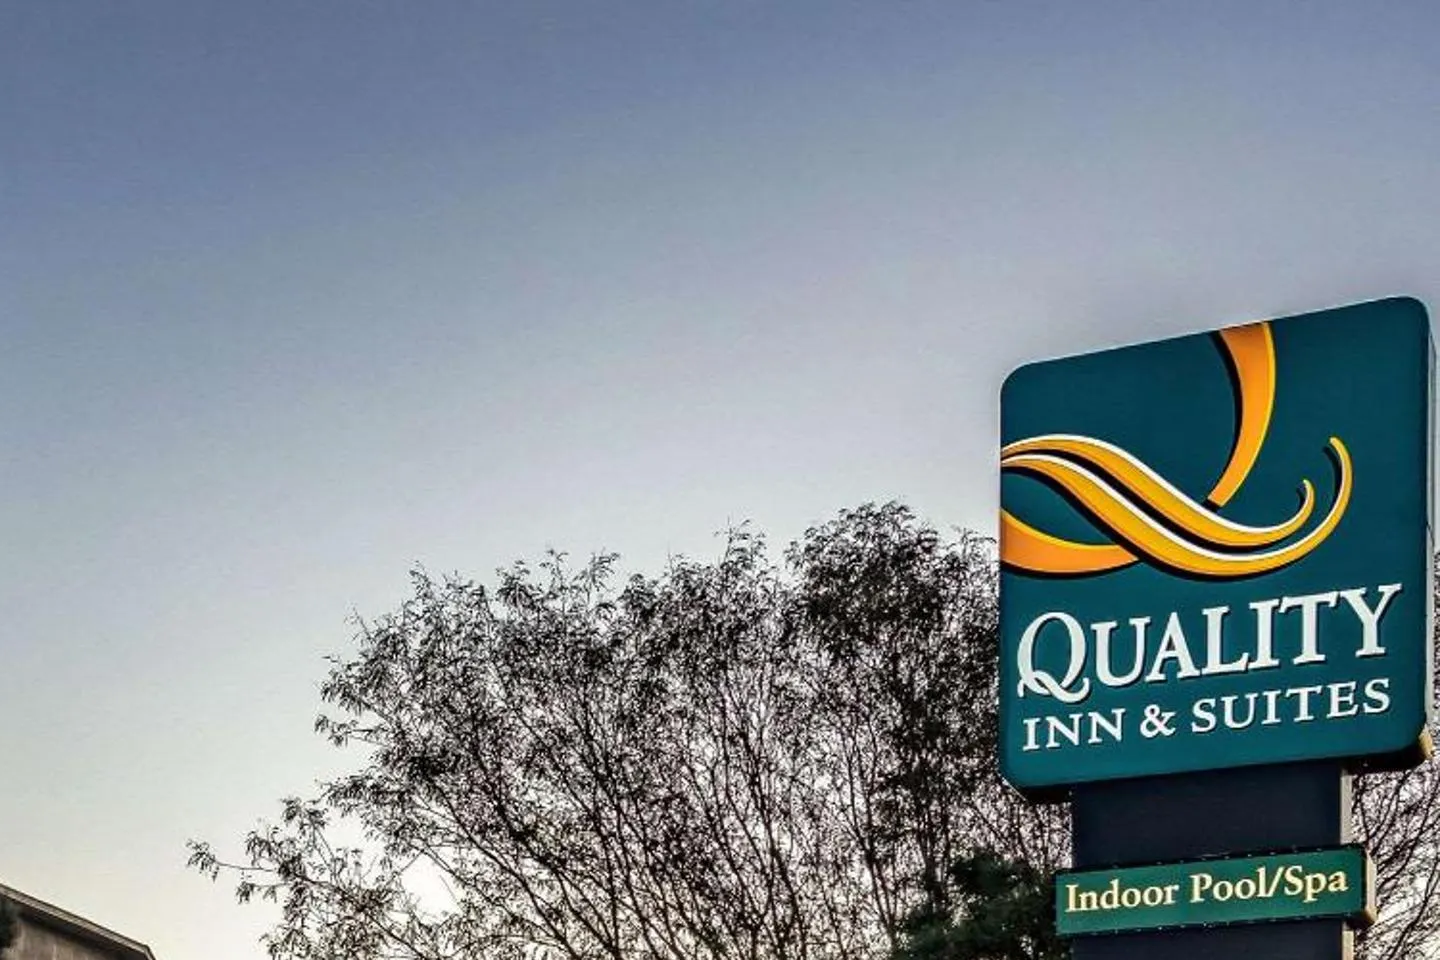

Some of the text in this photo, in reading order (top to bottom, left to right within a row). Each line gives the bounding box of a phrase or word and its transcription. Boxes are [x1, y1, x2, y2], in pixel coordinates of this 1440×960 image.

[1017, 583, 1402, 702] QUALITY
[1022, 678, 1391, 751] INN & SUITES
[1065, 865, 1349, 913] Indoor Pool/Spa
